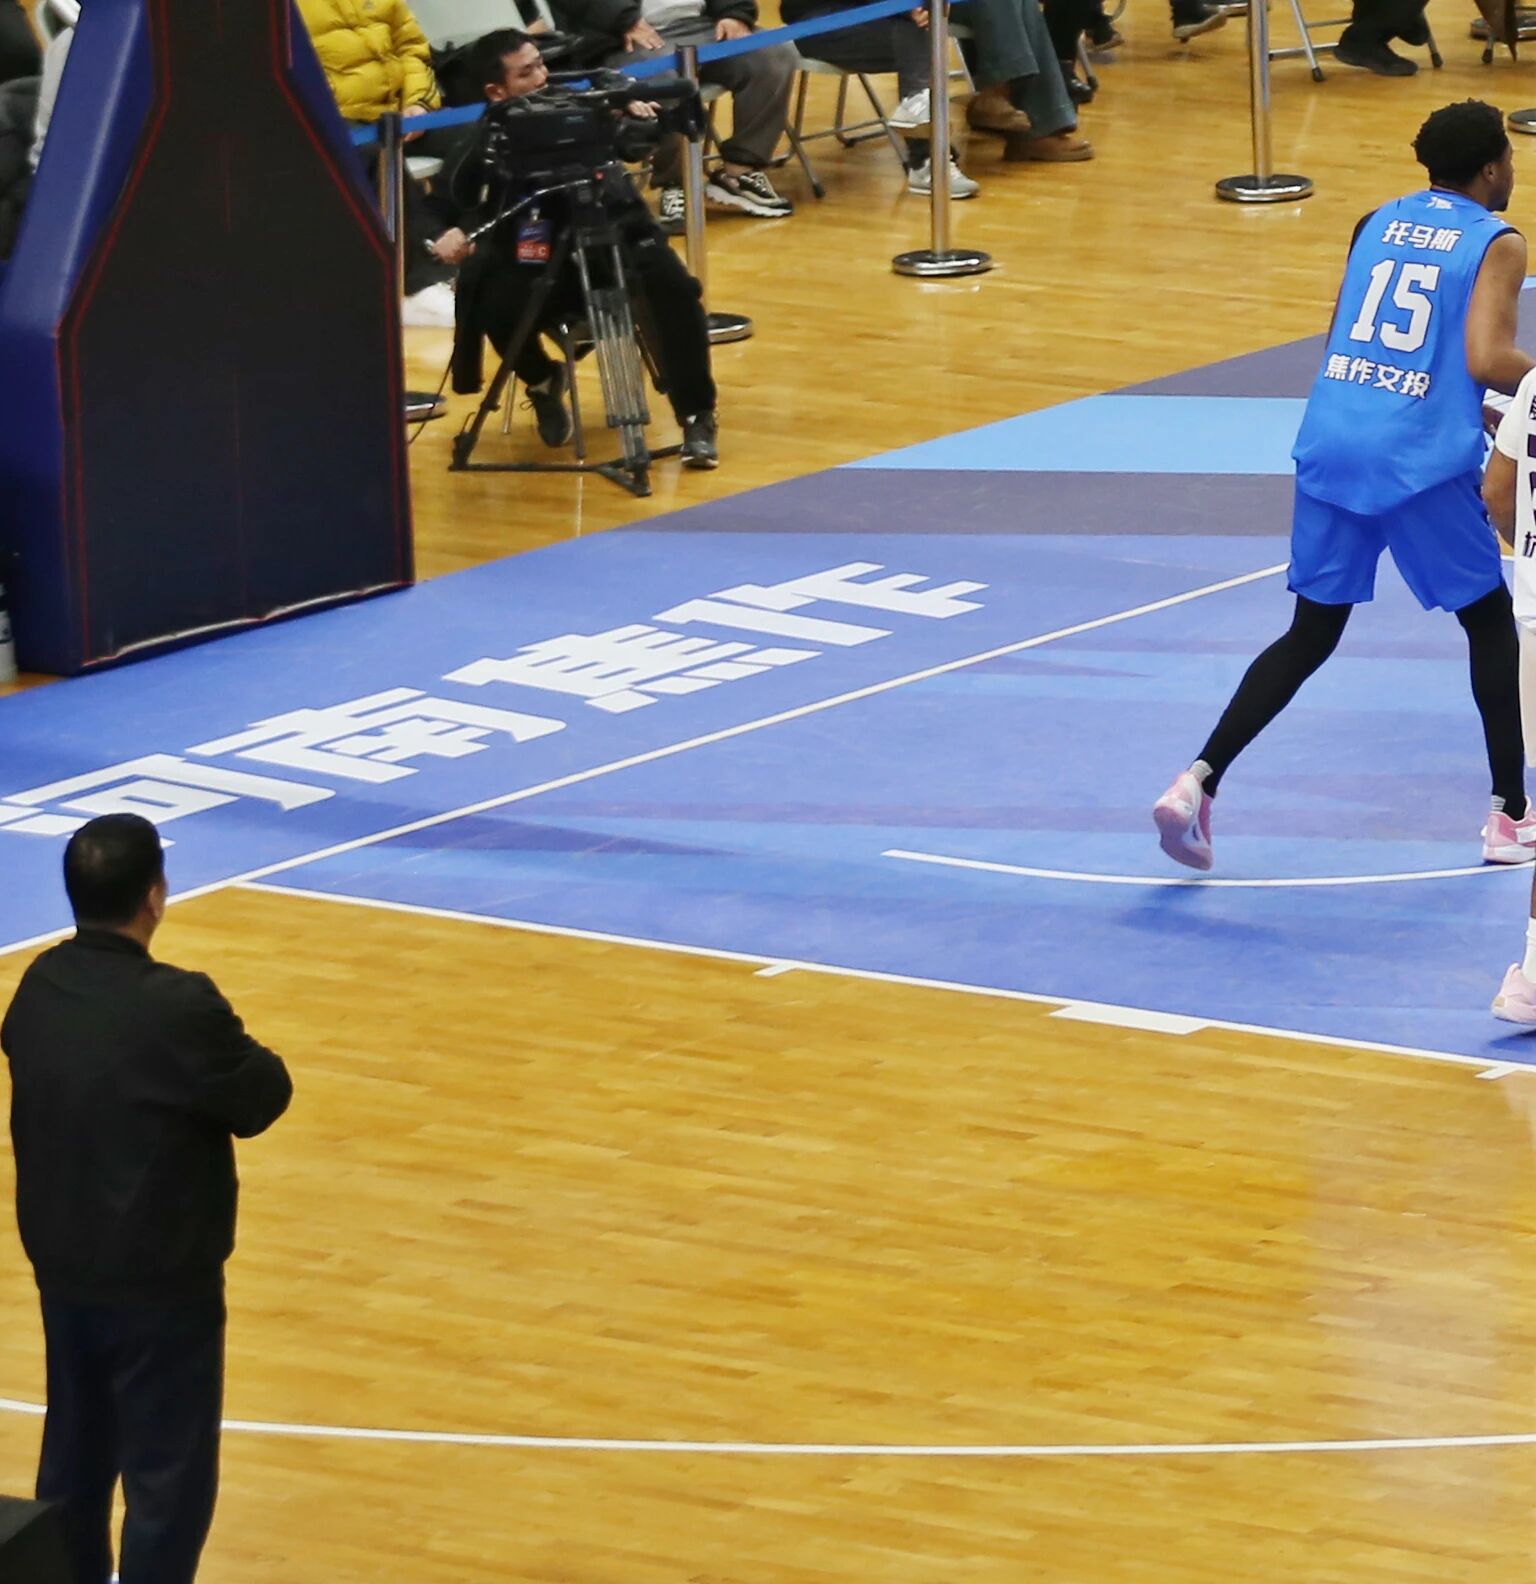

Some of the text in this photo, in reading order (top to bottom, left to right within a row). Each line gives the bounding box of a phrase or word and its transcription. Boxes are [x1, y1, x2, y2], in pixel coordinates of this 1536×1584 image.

[1382, 219, 1462, 253] 托马斯
[1349, 258, 1442, 353] 15
[1323, 353, 1432, 400] 焦作文投
